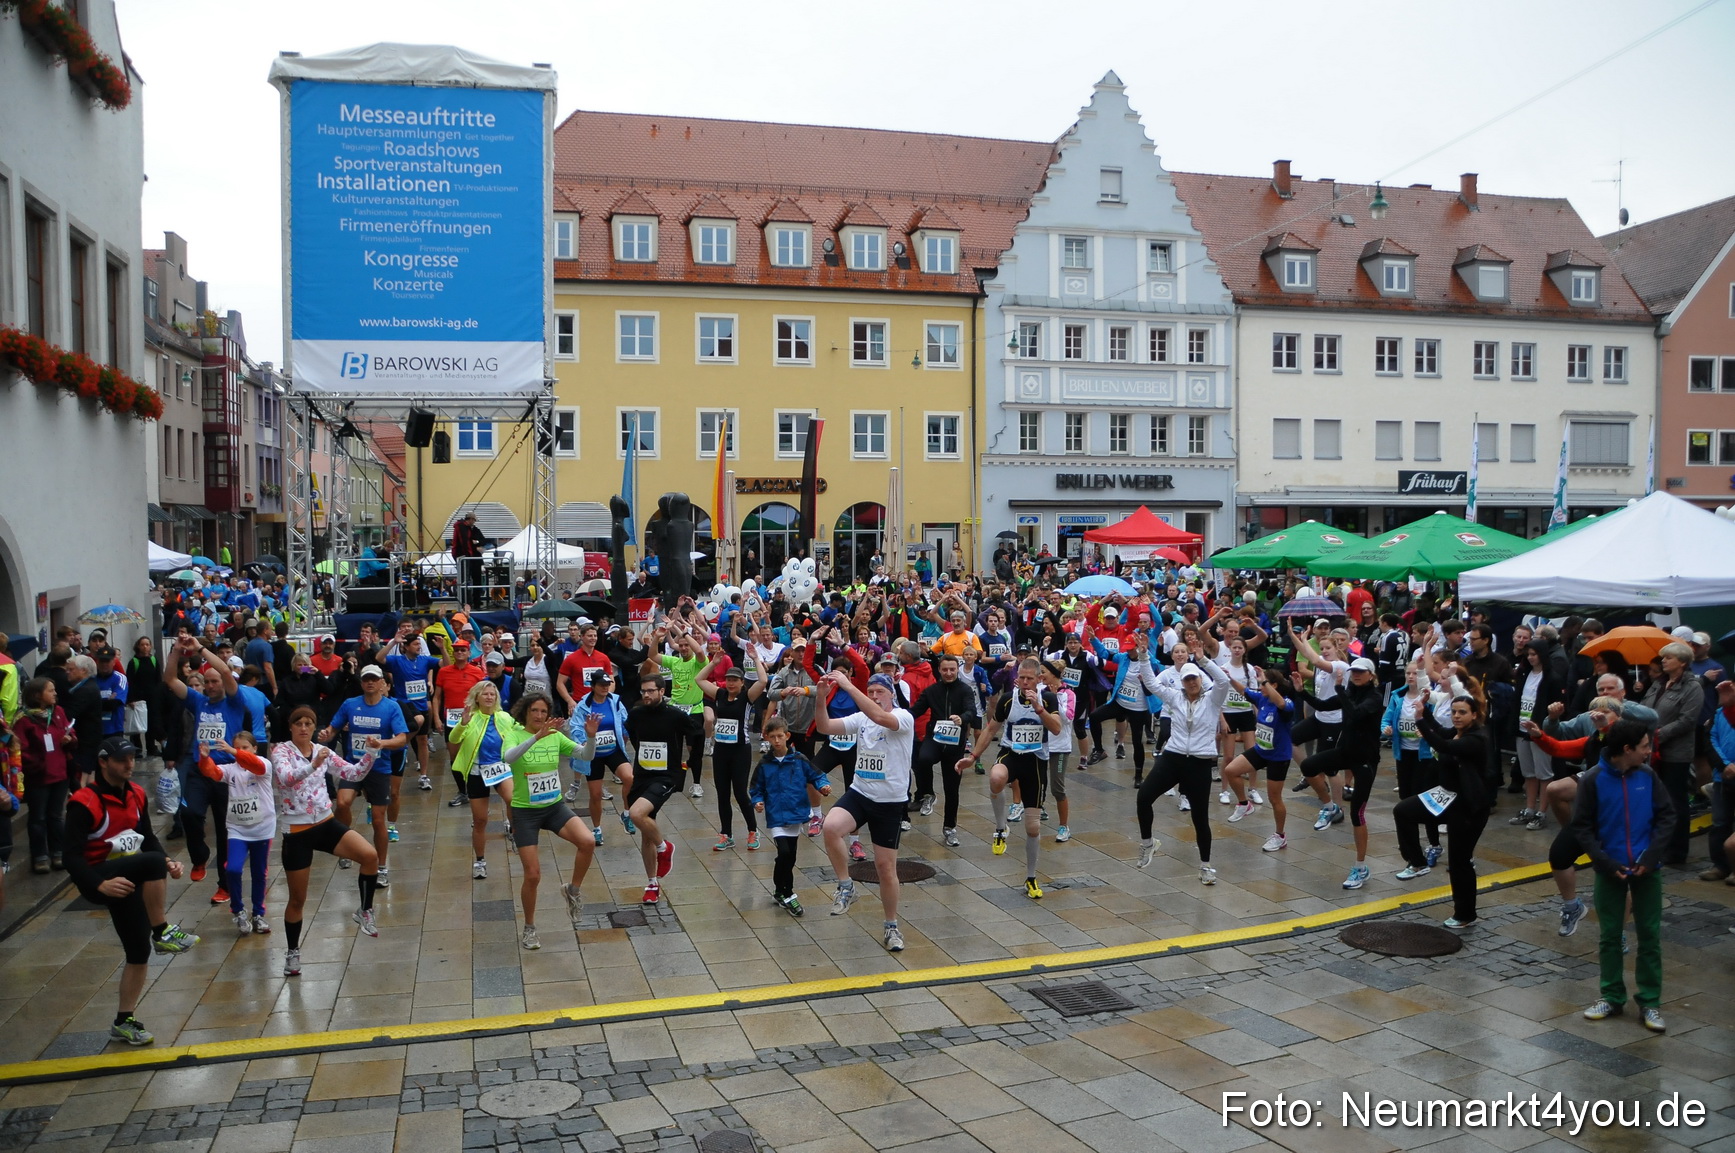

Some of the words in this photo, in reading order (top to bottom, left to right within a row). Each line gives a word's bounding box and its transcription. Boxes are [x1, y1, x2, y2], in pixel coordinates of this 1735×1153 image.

[340, 104, 496, 127] Messeauftritte
[317, 124, 462, 142] Hauptversammlungen
[465, 133, 479, 141] Get
[480, 134, 515, 142] together
[384, 141, 480, 158] Roadshows
[334, 156, 502, 176] Sportveranstaltungen
[317, 173, 450, 193] Installationen
[454, 184, 519, 192] TV-Produktionen
[332, 194, 460, 208] Kulturveranstaltungen
[354, 208, 408, 217] Fashionshows
[412, 209, 502, 219] Produktpräsentationen
[340, 218, 491, 238] Firmeneröffnungen
[364, 250, 459, 270] Kongresse
[414, 269, 454, 279] Musicals
[373, 277, 444, 292] Konzerte
[391, 292, 435, 300] Tourservice
[359, 317, 479, 331] www.barowski-ag.de
[374, 357, 467, 372] BAROWSKI
[473, 358, 498, 372] AG
[374, 372, 428, 380] Veranstaltungs-
[444, 373, 498, 381] Mediensysteme
[1069, 379, 1120, 393] BRILLEN
[1122, 381, 1167, 394] WEBER
[1056, 473, 1116, 489] BRILLEN
[1118, 474, 1175, 489] WEBER
[1401, 472, 1465, 493] frühauf
[407, 685, 425, 693] 3124
[1118, 687, 1136, 697] 2681
[199, 728, 222, 739] 2768
[716, 724, 736, 735] 2229
[936, 725, 959, 736] 2677
[1398, 721, 1416, 732] 508
[1015, 731, 1041, 743] 2132
[643, 748, 661, 760] 576
[858, 757, 883, 771] 3180
[532, 778, 559, 793] 2412
[231, 801, 257, 815] 4024
[119, 836, 138, 852] 337
